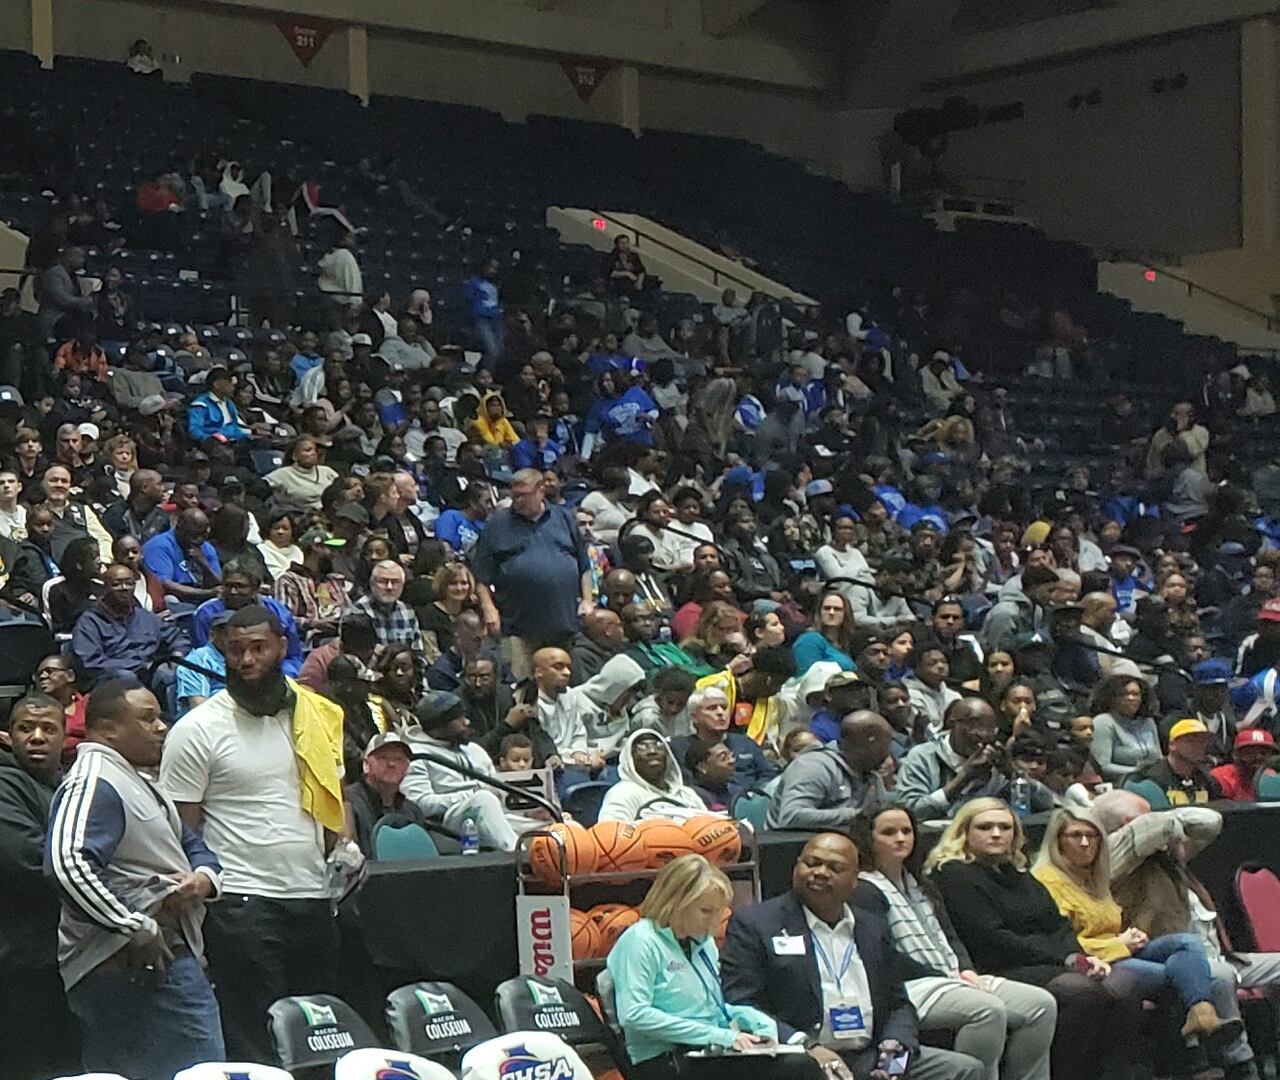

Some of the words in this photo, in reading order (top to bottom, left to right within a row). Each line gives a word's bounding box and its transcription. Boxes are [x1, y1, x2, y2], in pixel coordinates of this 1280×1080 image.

[698, 826, 734, 848] Wilson
[425, 1019, 472, 1041] COLISEUM
[534, 1011, 580, 1029] COLISEUM
[307, 1032, 354, 1052] COLISEUM
